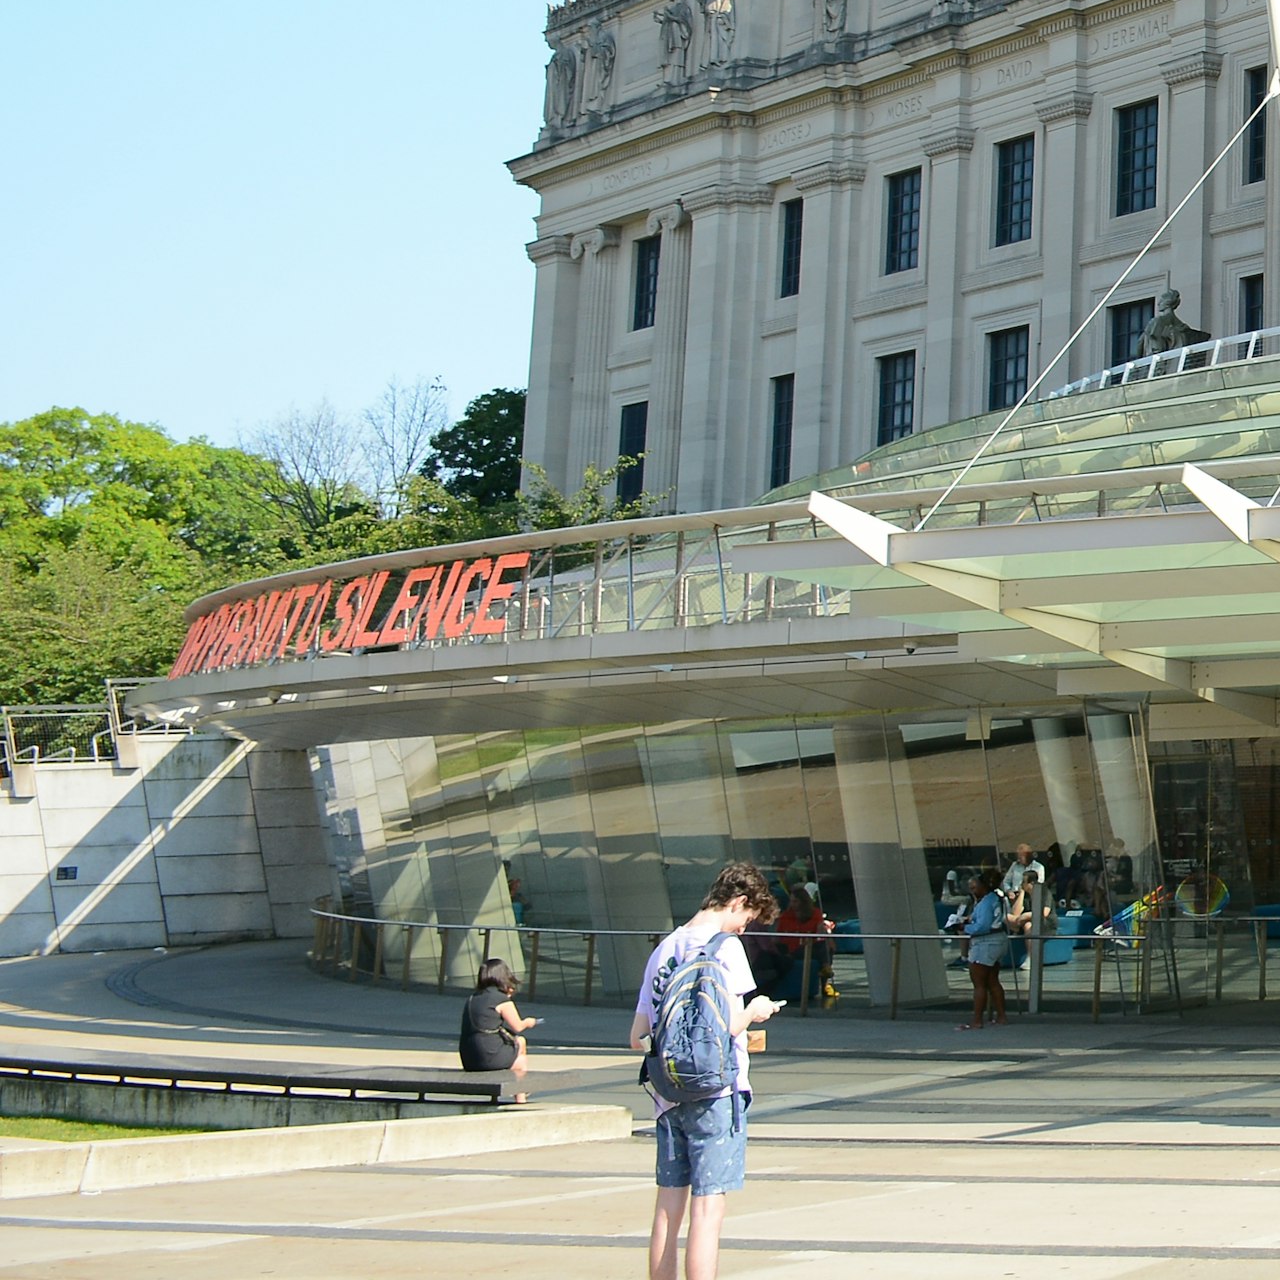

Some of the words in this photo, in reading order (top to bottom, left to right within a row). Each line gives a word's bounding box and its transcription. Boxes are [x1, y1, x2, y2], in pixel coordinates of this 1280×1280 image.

[1103, 14, 1169, 51] JEREMIAH
[997, 60, 1032, 85] DAVID
[887, 95, 922, 120] MOSES
[321, 552, 531, 652] SILENCE
